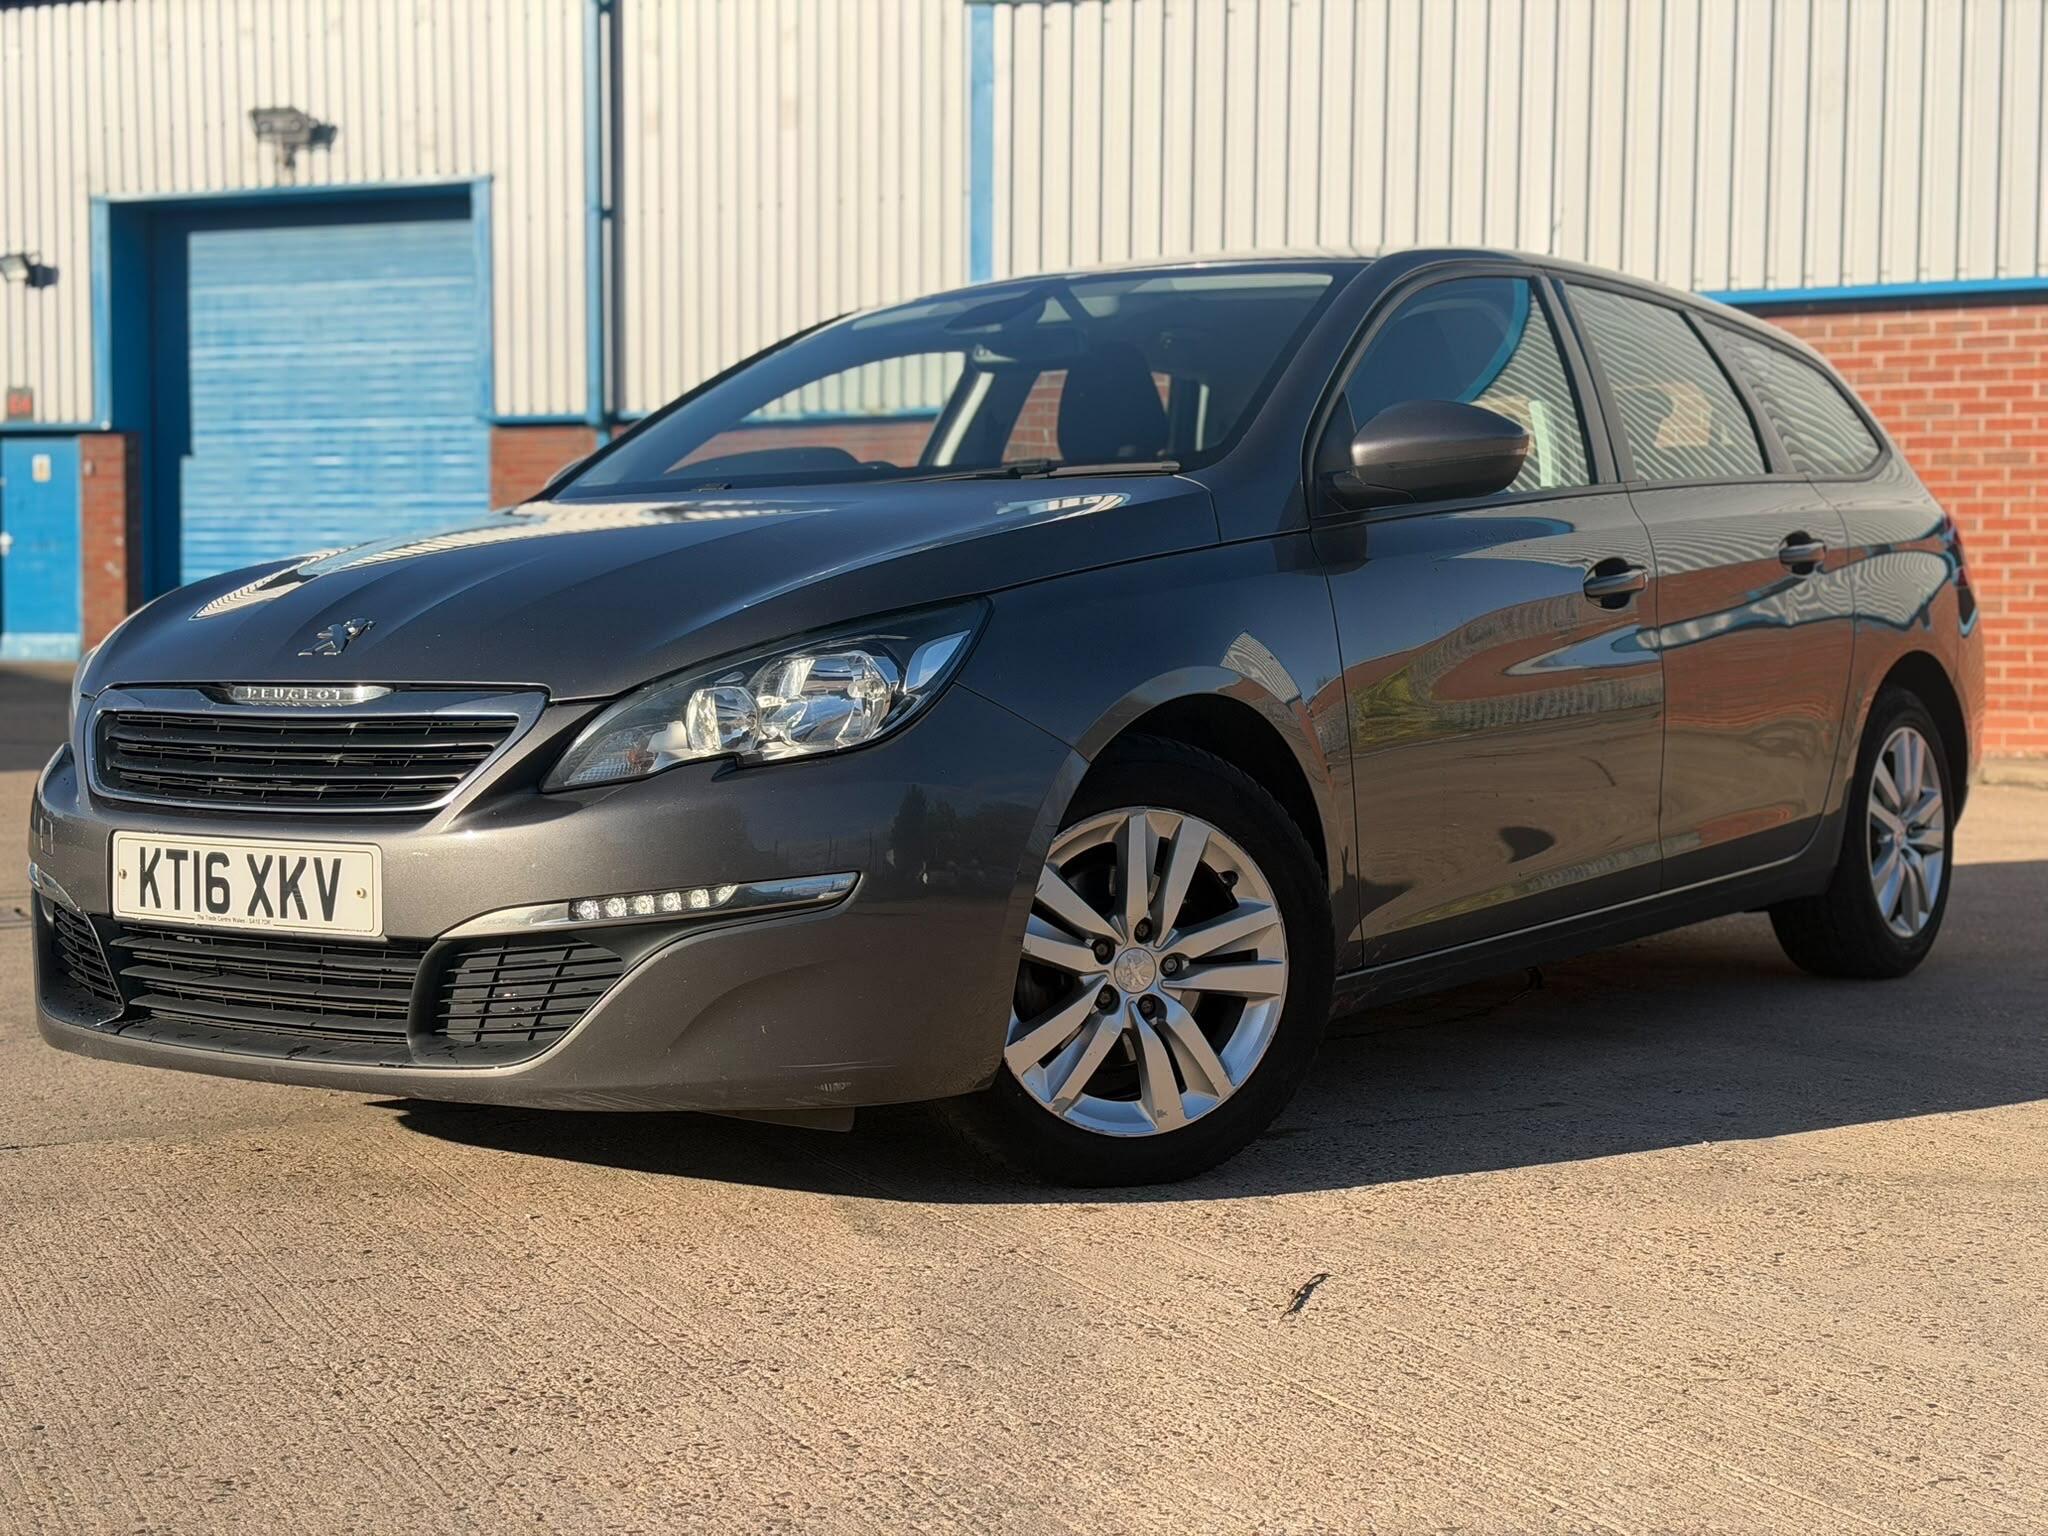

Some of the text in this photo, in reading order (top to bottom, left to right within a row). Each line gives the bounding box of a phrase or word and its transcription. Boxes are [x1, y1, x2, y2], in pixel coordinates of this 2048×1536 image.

[247, 686, 344, 700] PEUGEOT
[139, 846, 342, 922] KT16 XKV
